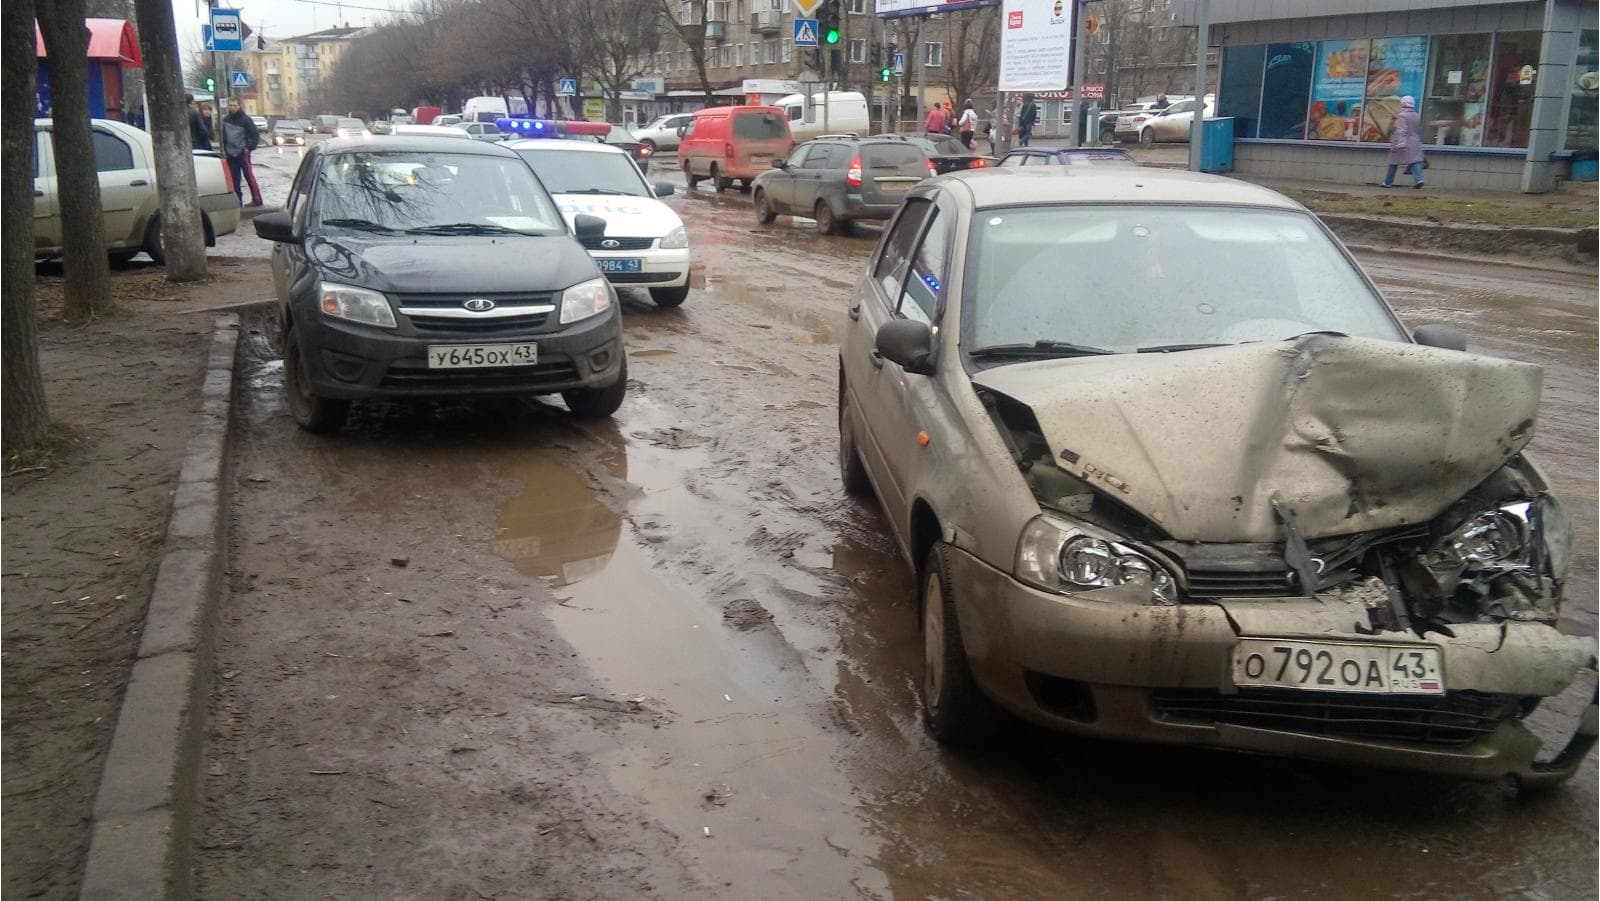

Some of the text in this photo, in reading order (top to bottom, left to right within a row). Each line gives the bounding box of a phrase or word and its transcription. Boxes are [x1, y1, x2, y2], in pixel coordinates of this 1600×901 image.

[437, 345, 531, 366] У645ОХ 43
[1245, 647, 1426, 688] О792ОА 43
